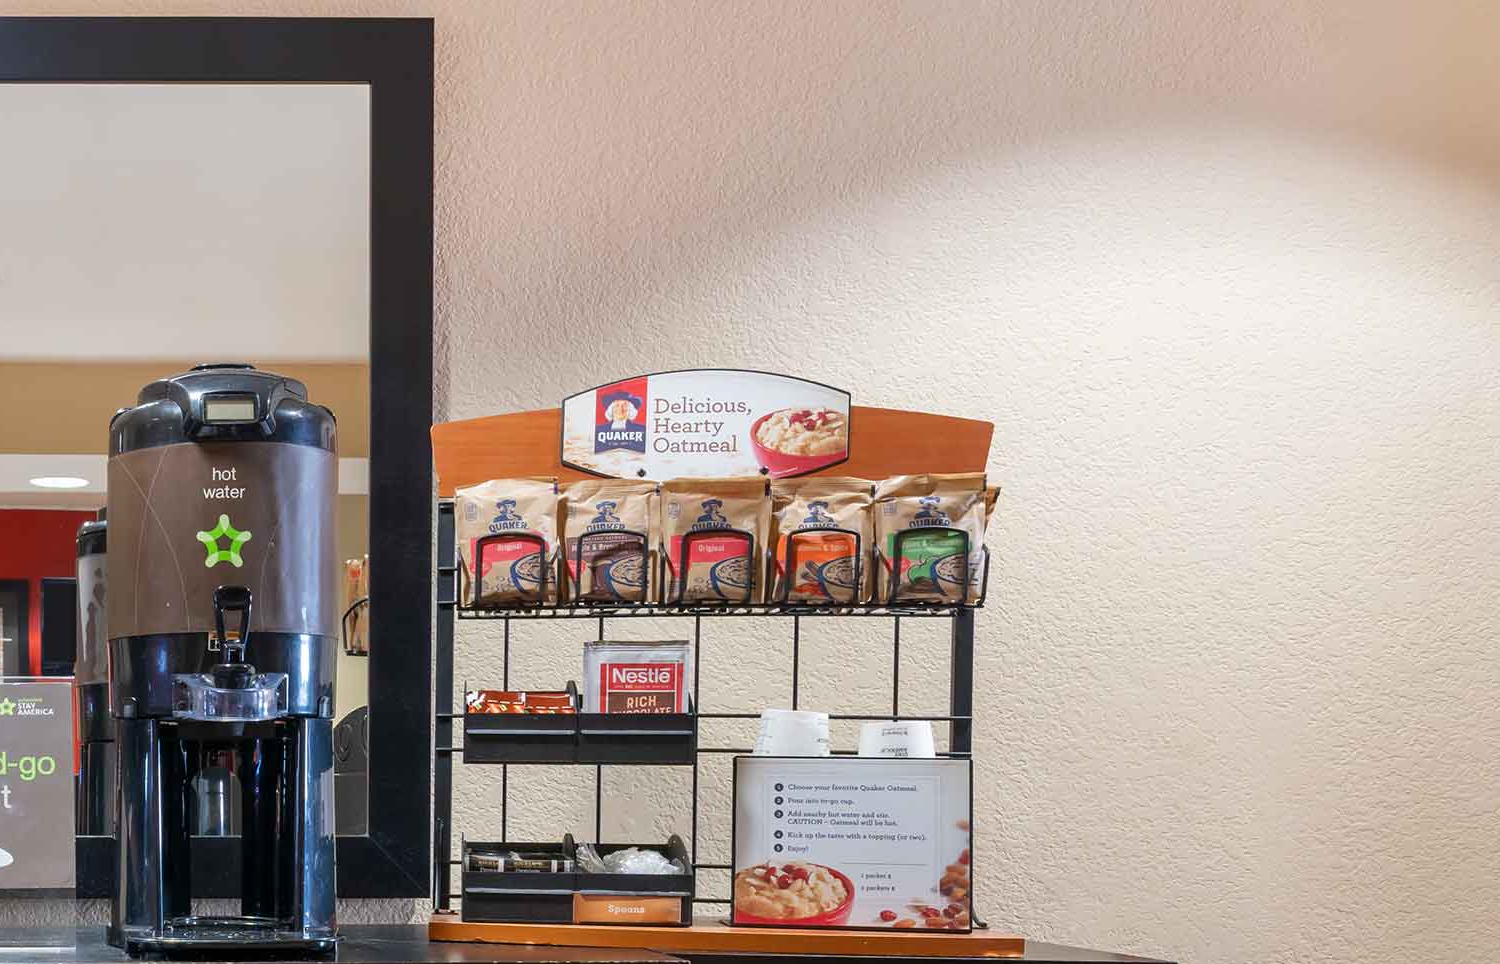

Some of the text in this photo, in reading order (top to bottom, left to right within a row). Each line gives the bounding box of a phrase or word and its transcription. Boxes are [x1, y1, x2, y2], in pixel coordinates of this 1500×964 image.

[653, 397, 752, 415] Delicious,
[653, 418, 725, 437] Hearty
[597, 431, 643, 443] QUAKER
[653, 435, 739, 453] Oatmeal
[212, 467, 237, 481] hot
[203, 485, 246, 499] water
[488, 521, 528, 533] QUAKER
[626, 695, 657, 709] RICH
[607, 904, 645, 915] Spoons
